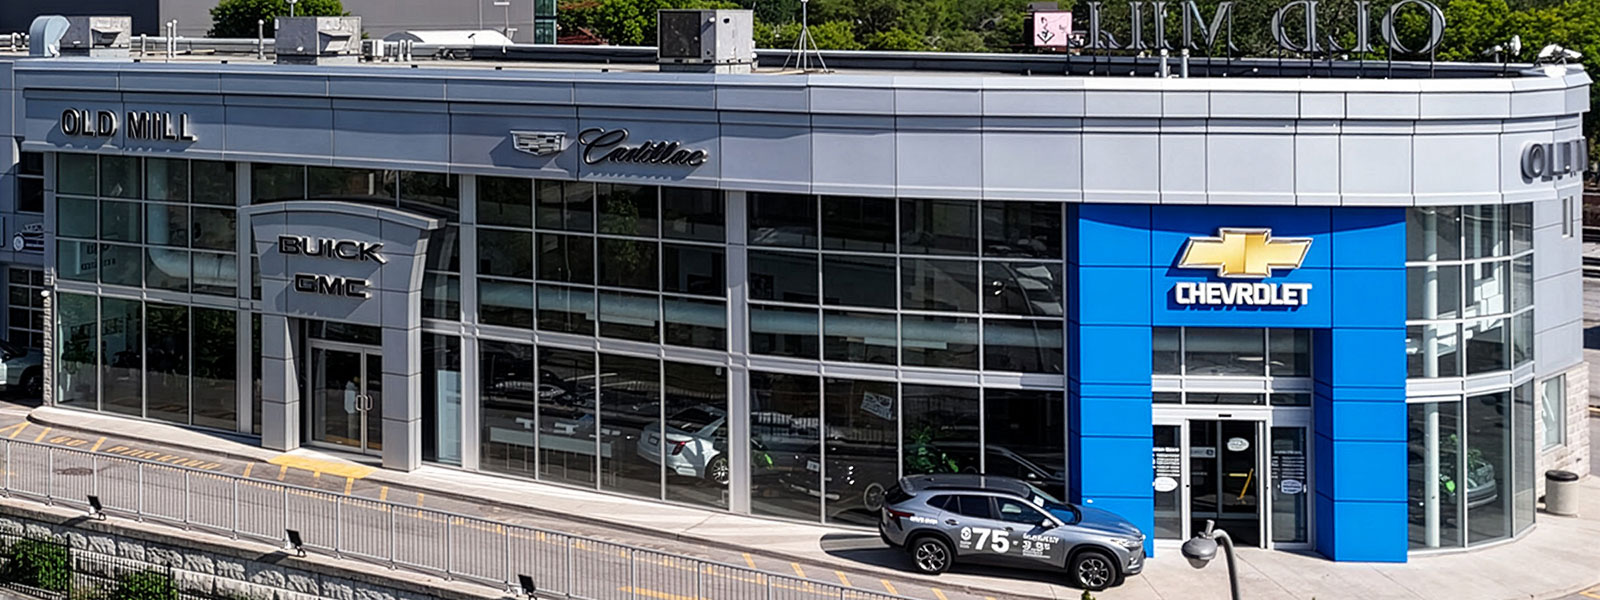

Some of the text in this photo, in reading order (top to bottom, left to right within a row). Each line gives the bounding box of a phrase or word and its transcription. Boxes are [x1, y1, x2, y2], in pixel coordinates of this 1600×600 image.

[61, 108, 198, 141] OLD MILL
[578, 128, 708, 166] Cadillac
[278, 235, 387, 265] BUICK
[294, 273, 372, 299] GMC
[1175, 282, 1313, 306] CHEVROLET
[972, 527, 1010, 554] 75
